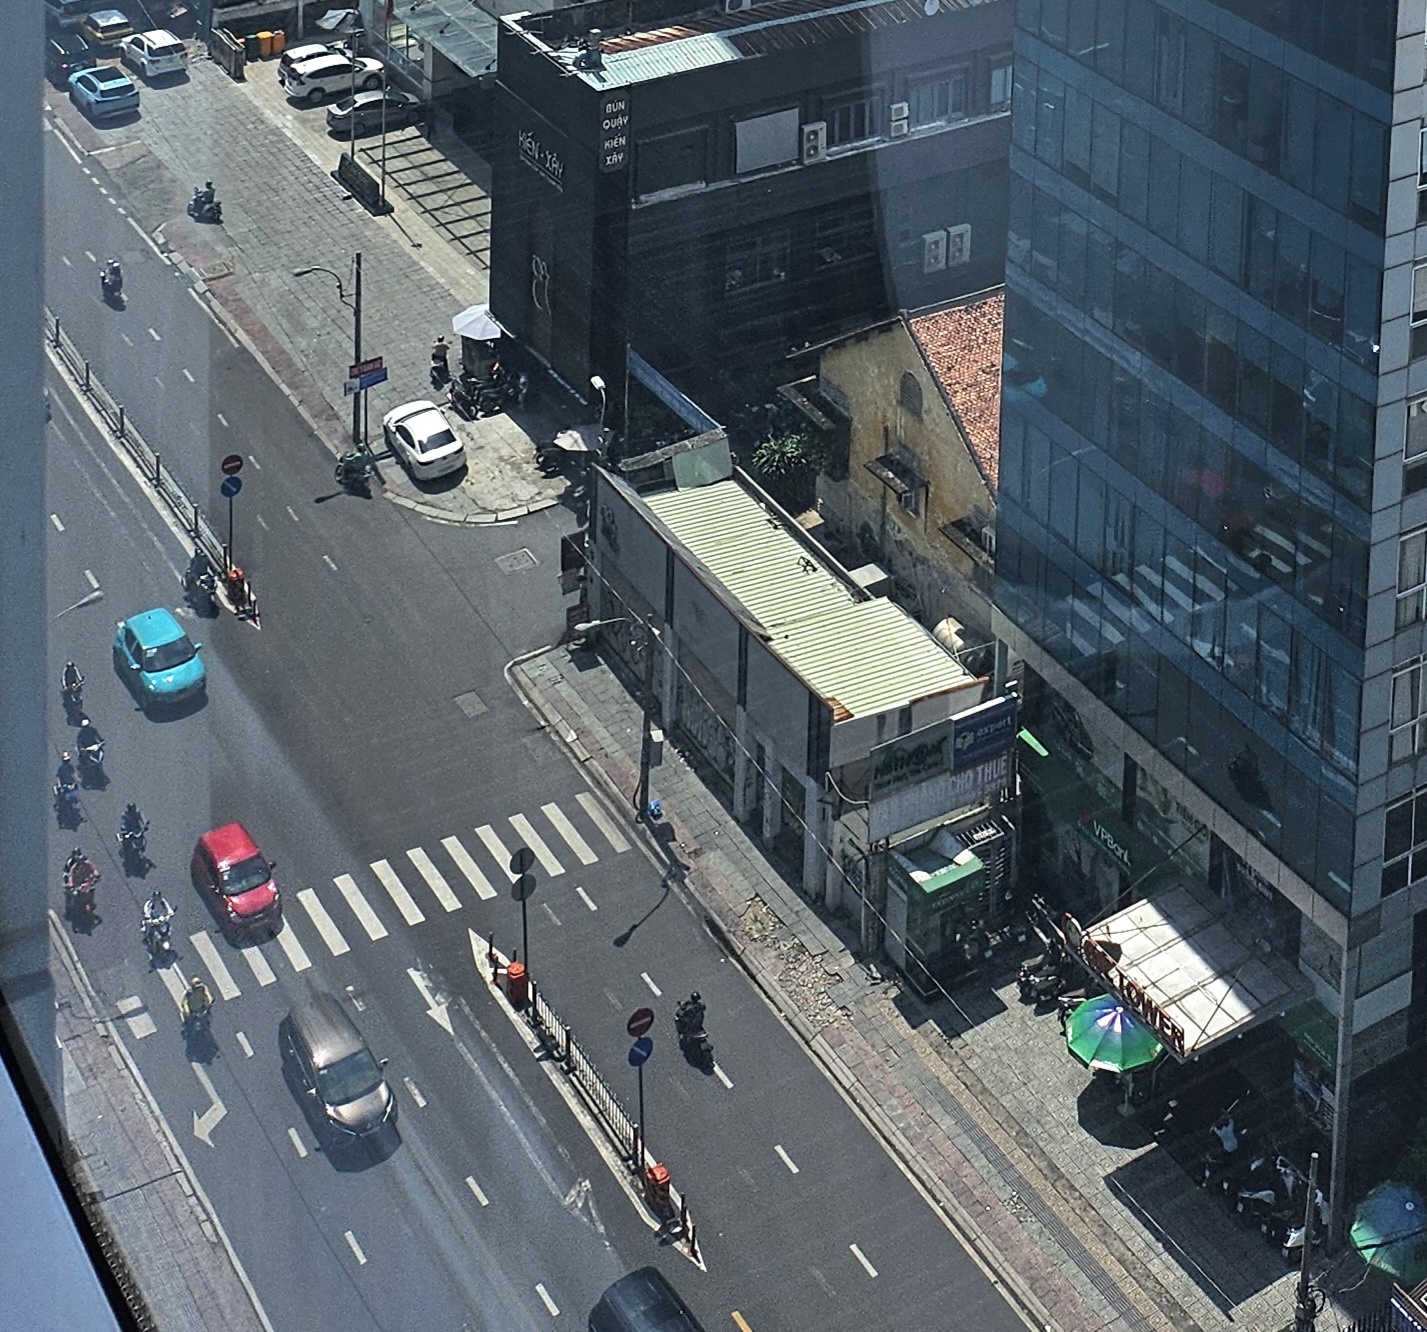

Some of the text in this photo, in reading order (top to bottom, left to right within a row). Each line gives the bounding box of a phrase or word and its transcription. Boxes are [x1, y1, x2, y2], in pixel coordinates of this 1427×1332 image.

[606, 100, 625, 113] BÚN
[518, 129, 540, 160] KIẾN
[604, 133, 626, 150] KIẾN
[605, 152, 624, 165] XÂY
[1093, 819, 1132, 868] VPBank
[1112, 966, 1185, 1057] TOWER
